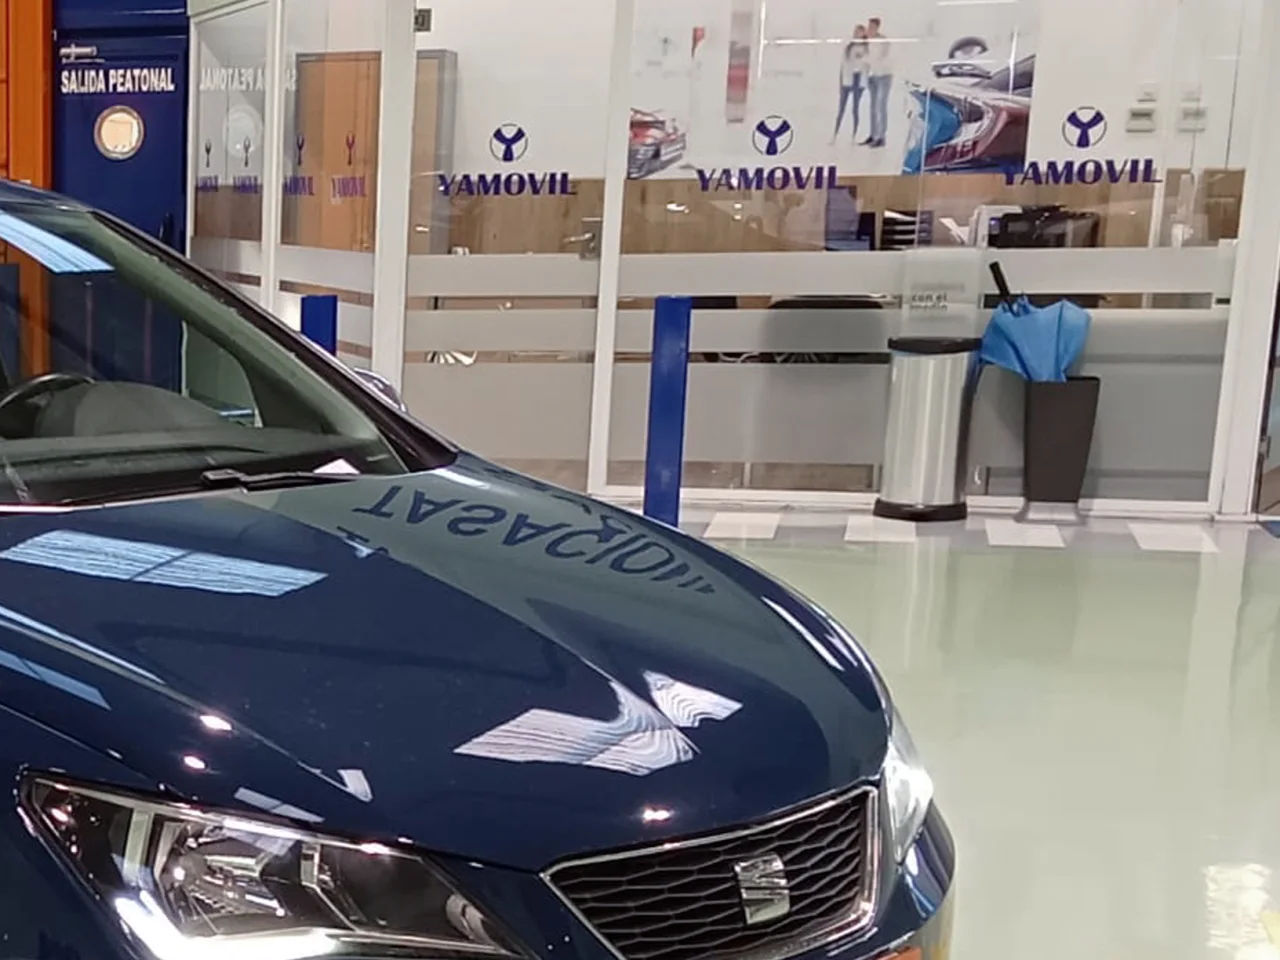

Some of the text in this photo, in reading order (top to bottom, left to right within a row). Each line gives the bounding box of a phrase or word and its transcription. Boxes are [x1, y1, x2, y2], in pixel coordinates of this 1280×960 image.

[61, 67, 175, 93] SALIDA PEATONAL
[437, 171, 577, 197] YAMOVIL
[697, 165, 856, 192] YAMOVIL
[1003, 159, 1162, 186] YAMOVIL
